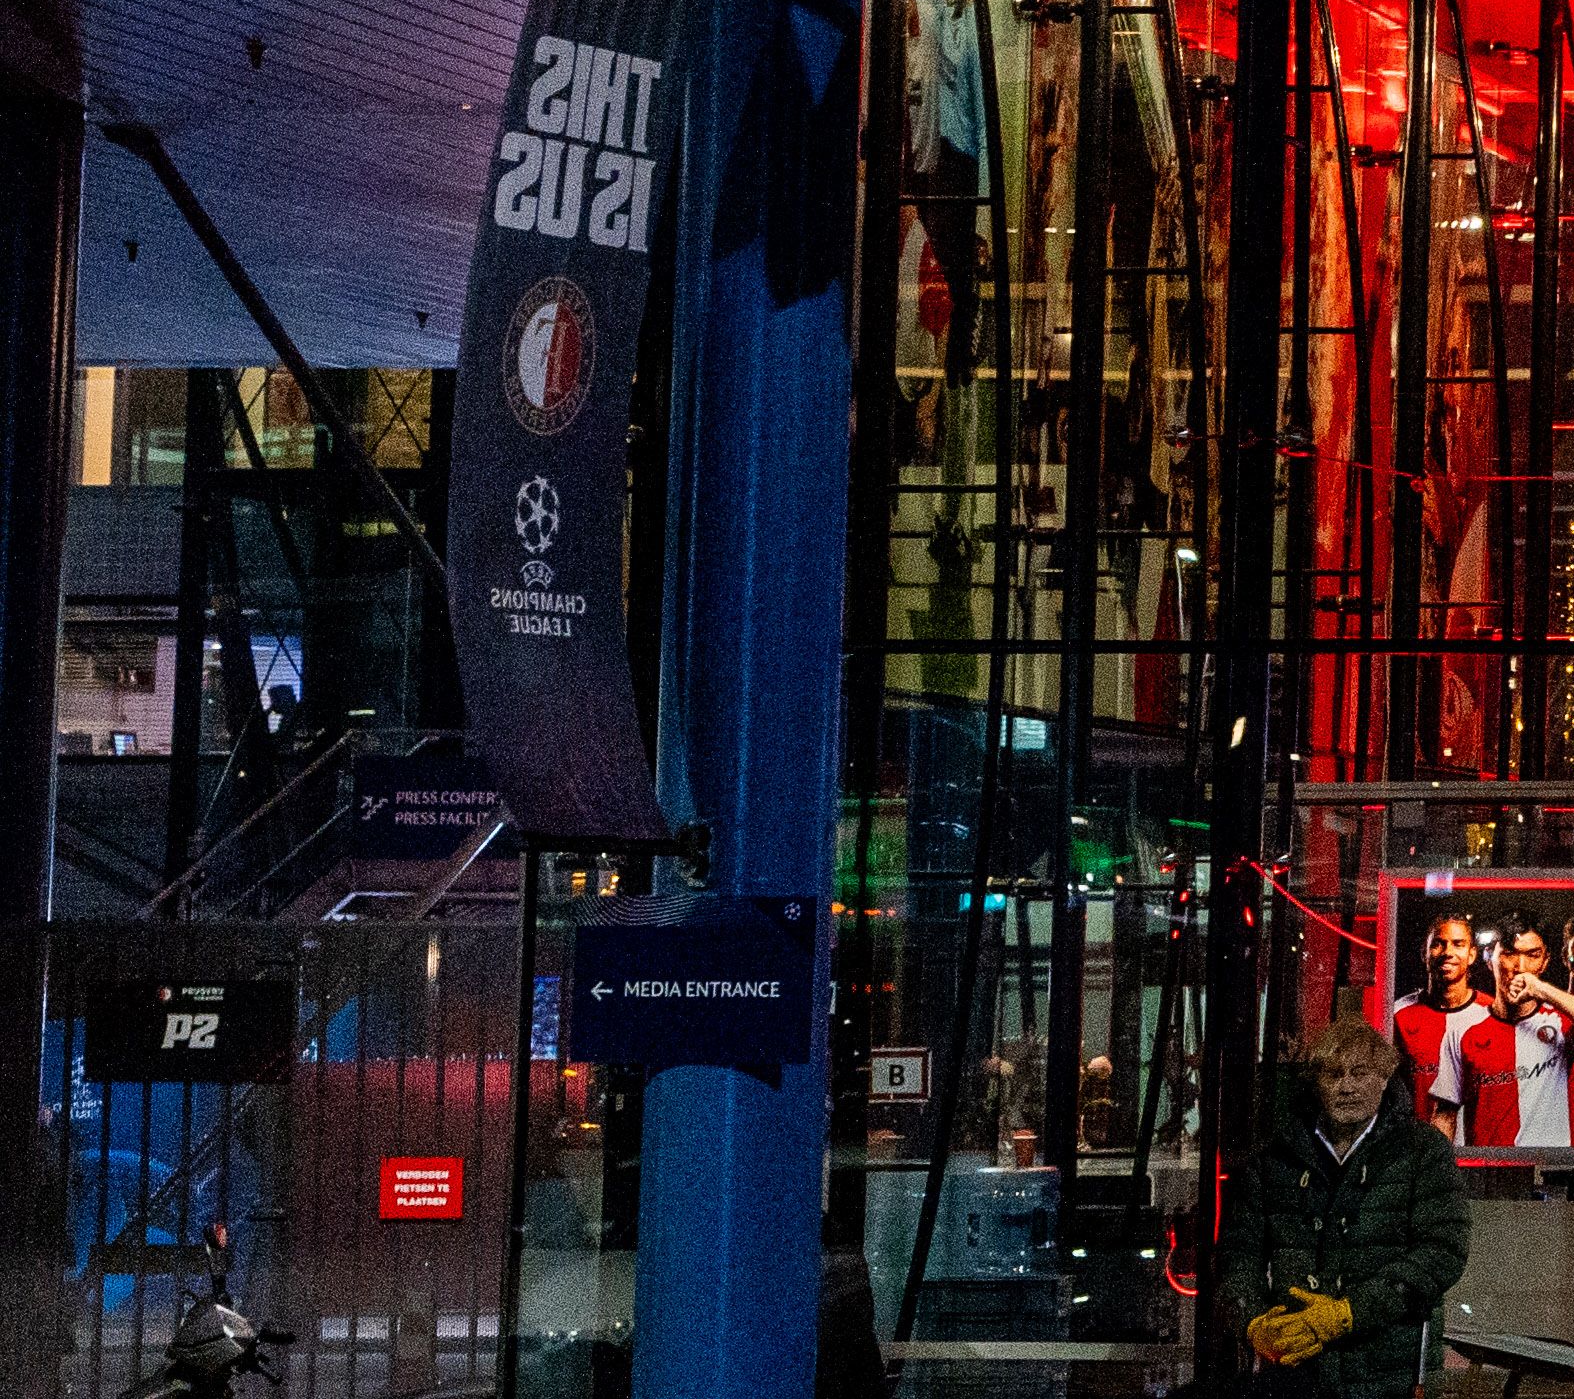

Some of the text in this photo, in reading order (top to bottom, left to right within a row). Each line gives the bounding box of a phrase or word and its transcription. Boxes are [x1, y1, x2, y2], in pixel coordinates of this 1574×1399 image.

[395, 790, 498, 805] PRESS CONFER
[394, 811, 437, 826] PRESS
[624, 980, 780, 998] MEDIA ENTRANCE
[161, 1013, 219, 1050] P2
[888, 1064, 905, 1087] B
